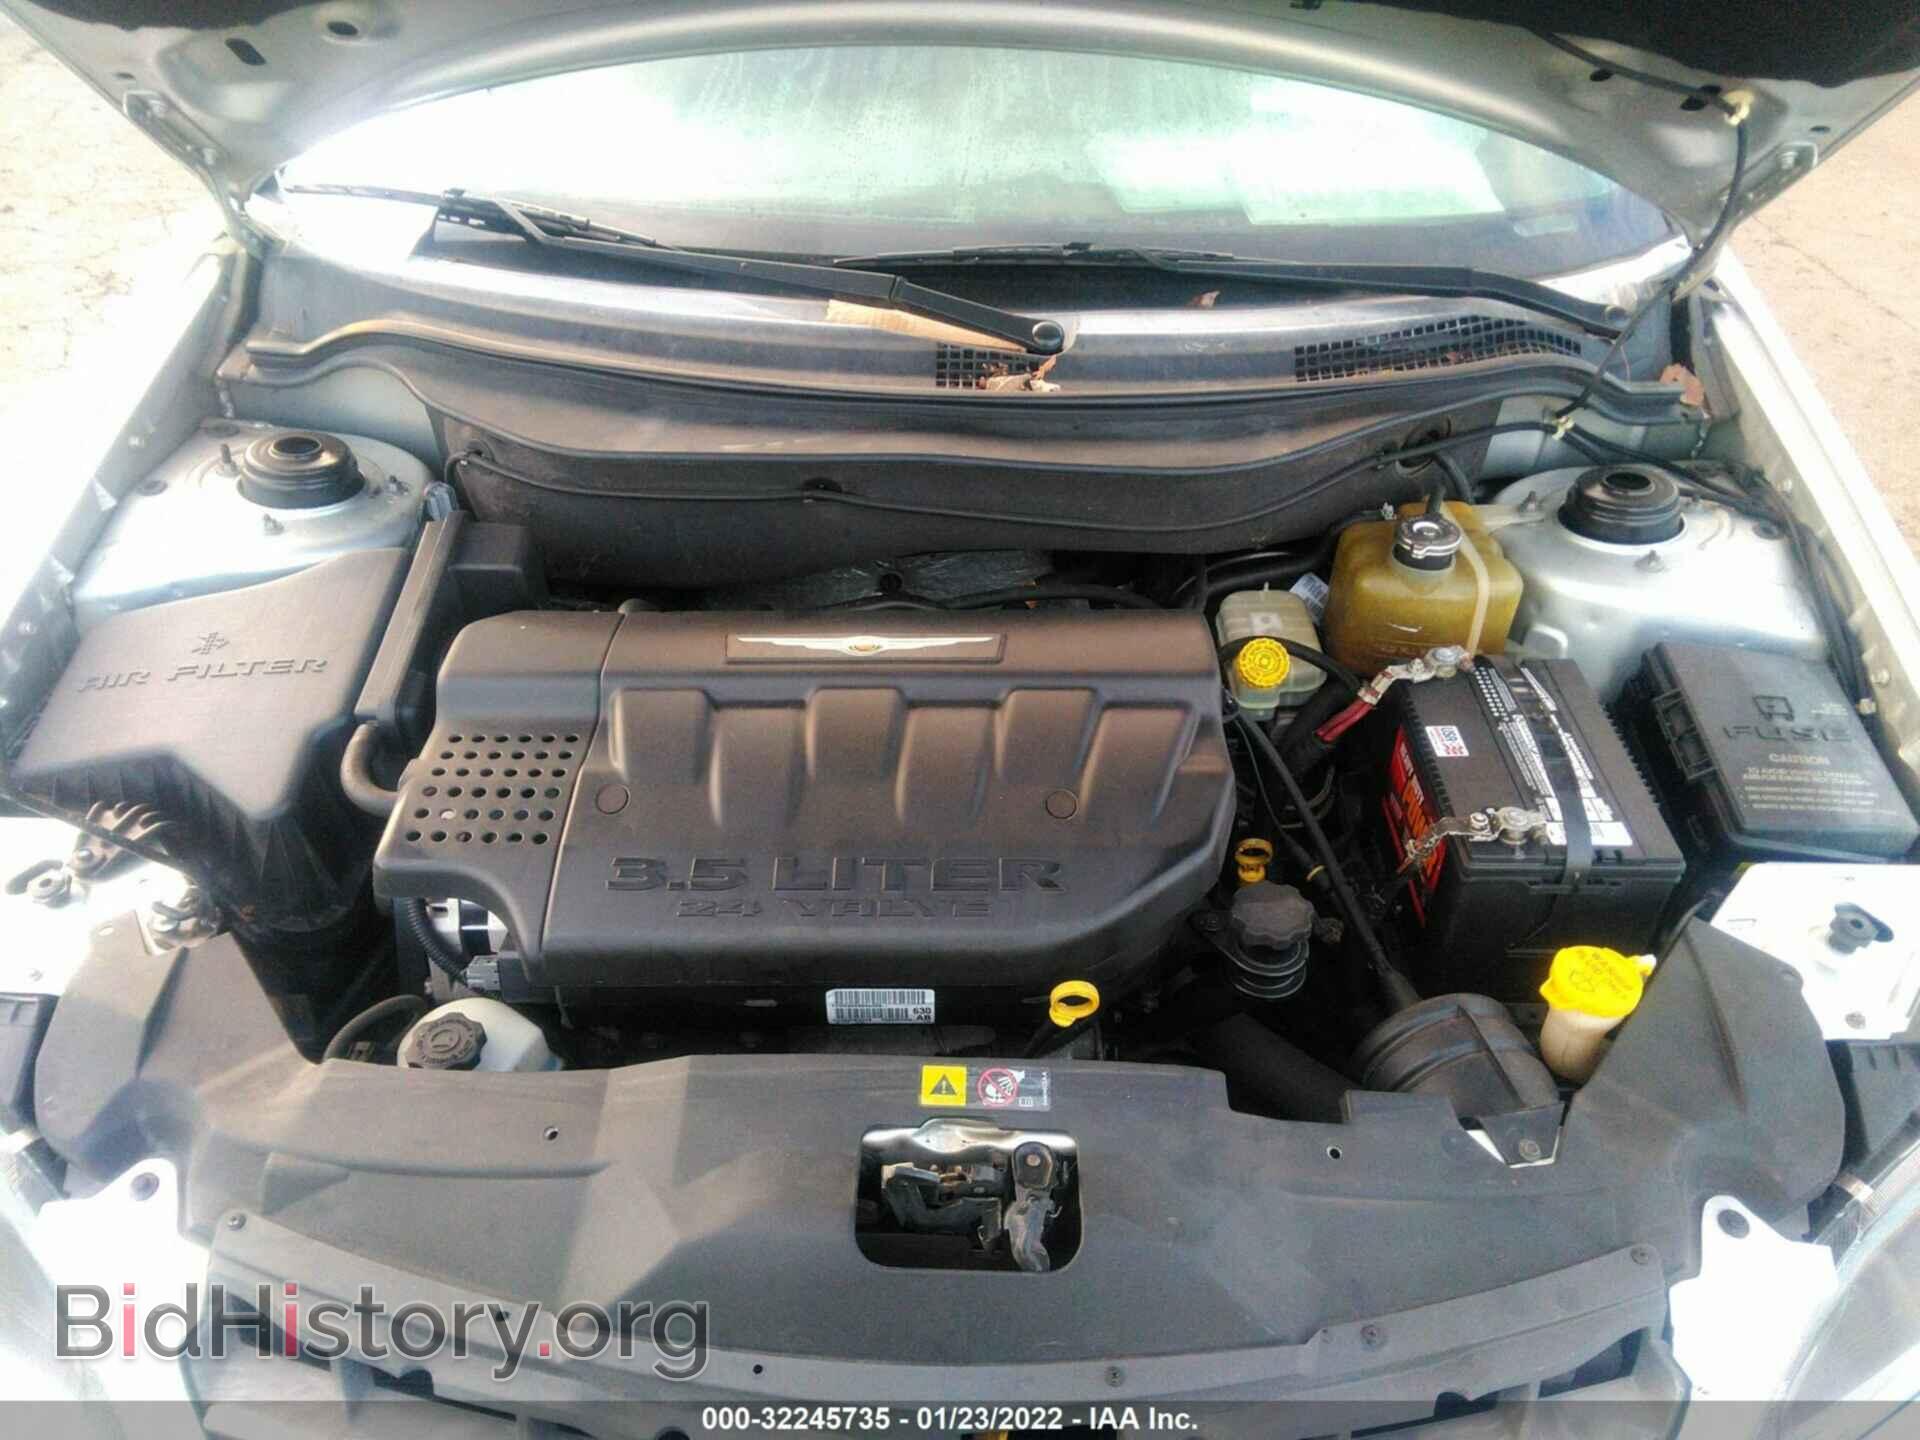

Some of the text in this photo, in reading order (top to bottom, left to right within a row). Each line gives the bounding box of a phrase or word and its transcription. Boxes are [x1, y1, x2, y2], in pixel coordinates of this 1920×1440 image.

[78, 659, 328, 693] AIR FILTER
[1723, 725, 1851, 742] FUSE
[605, 856, 1066, 892] 3.5 LITER
[677, 900, 994, 918] 24 VALVE
